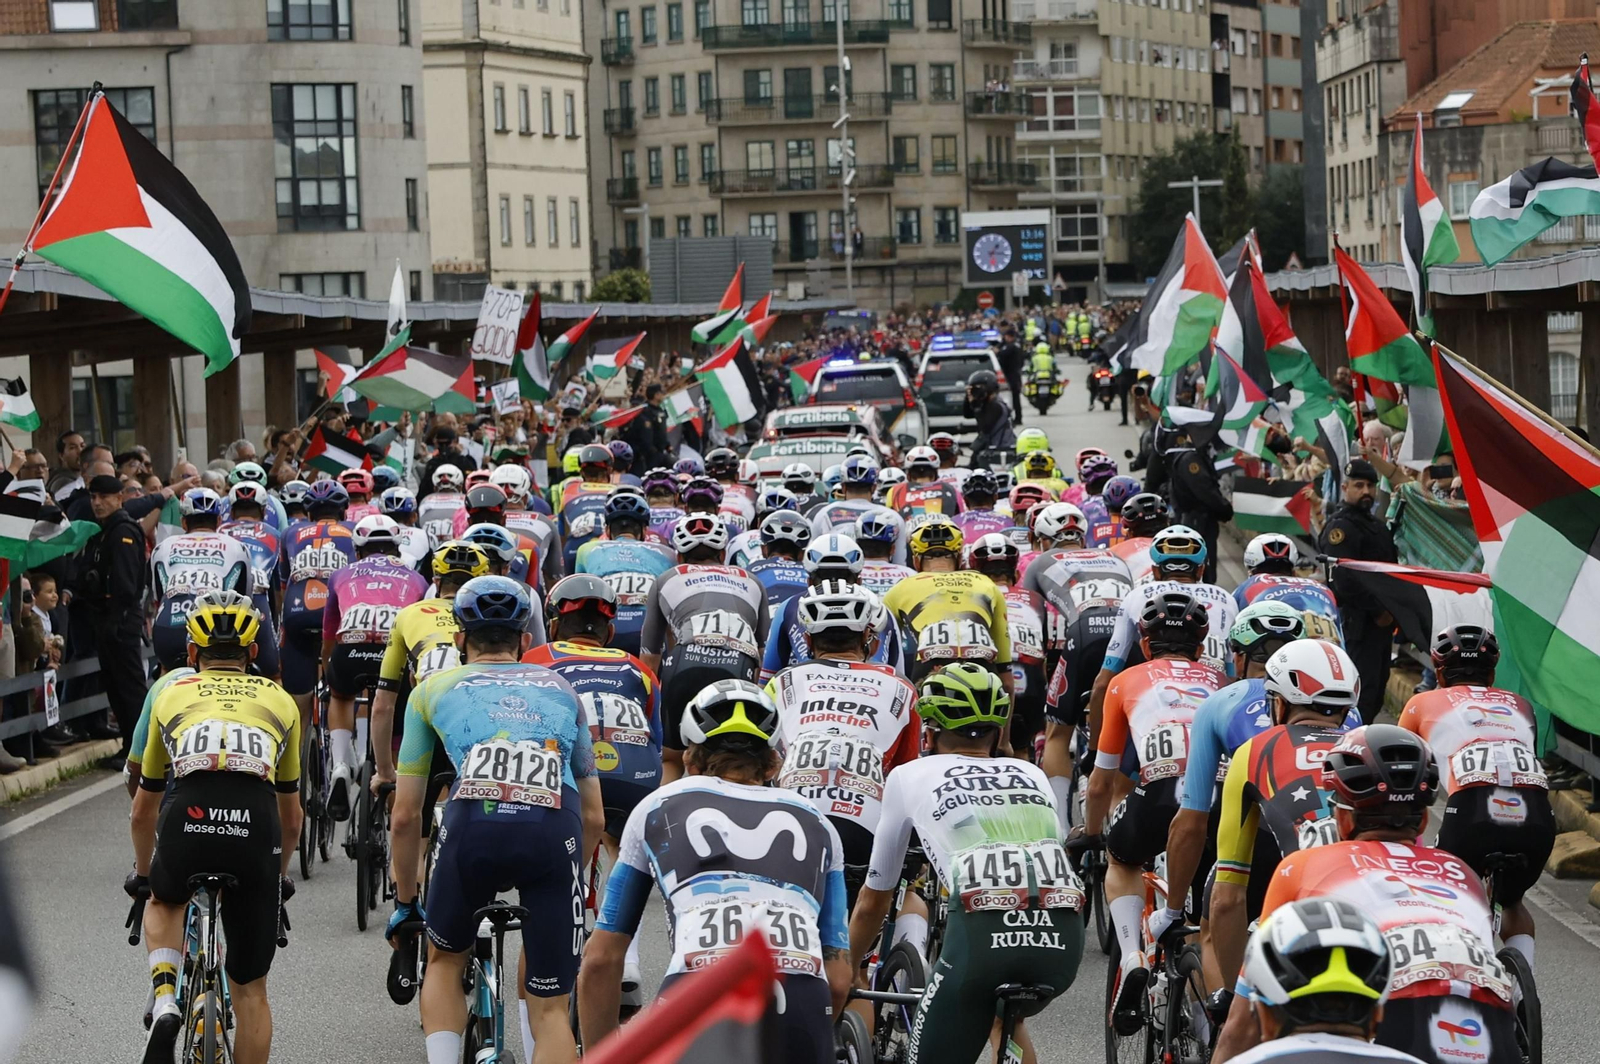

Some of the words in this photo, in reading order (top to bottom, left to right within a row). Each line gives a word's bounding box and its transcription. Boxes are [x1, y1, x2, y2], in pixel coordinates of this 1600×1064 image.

[784, 411, 850, 424] Fertiberia
[770, 442, 846, 456] Fertiberia
[198, 542, 226, 551] Bull
[169, 570, 187, 587] 43
[200, 571, 219, 589] 43
[773, 569, 801, 577] FDJ
[366, 582, 392, 590] BH
[684, 573, 748, 592] deceuninck
[1076, 583, 1101, 602] 72
[699, 613, 723, 634] 71
[925, 622, 950, 646] 15
[968, 623, 991, 646] 15
[1017, 625, 1037, 646] 65
[686, 643, 740, 658] BRUSTOR
[1200, 636, 1225, 660] 01
[424, 648, 449, 673] 17
[684, 653, 701, 662] SUN
[702, 656, 739, 665] SYSTEMS
[805, 672, 884, 687] FANTINI
[1147, 667, 1219, 683] INEOS
[198, 683, 258, 692] lease
[453, 679, 562, 691] ASTANA
[1447, 690, 1518, 705] INEOS
[178, 724, 210, 758] 16
[231, 728, 263, 759] 16
[1145, 729, 1173, 763] 66
[841, 742, 883, 784] 183
[1460, 747, 1489, 773] 67
[510, 750, 560, 792] 128
[634, 770, 656, 779] Santini
[944, 764, 1025, 779] CAJA
[1388, 793, 1415, 802] KASK
[209, 807, 251, 823] VISMA
[497, 803, 531, 812] FREEDOM
[833, 802, 863, 817] Daily
[932, 793, 1005, 822] SEGUROS
[184, 822, 216, 834] lease
[963, 850, 1022, 890] 145
[1348, 853, 1467, 881] INEOS
[1395, 899, 1465, 919] TotalEnergies
[1003, 910, 1054, 927] CAJA
[698, 904, 743, 949] 36
[766, 909, 810, 952] 36
[990, 931, 1066, 951] RURAL
[922, 971, 945, 1014] RGA
[1439, 1047, 1486, 1060] TotalEnergies
